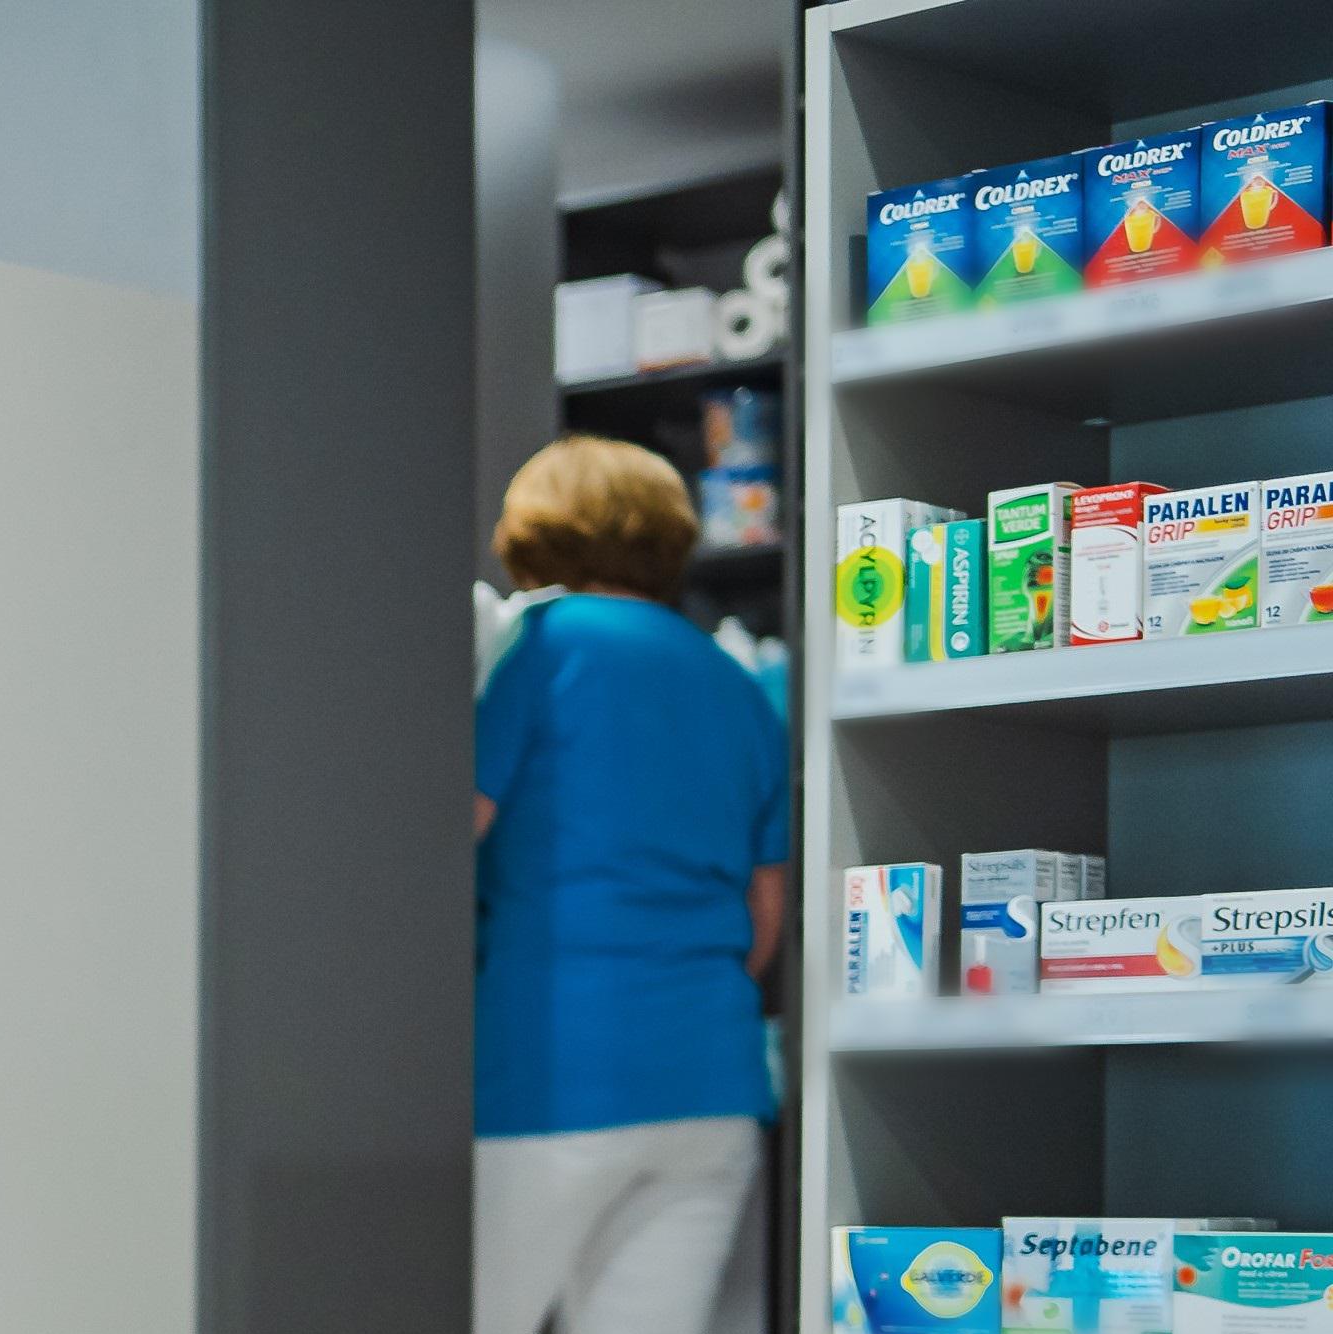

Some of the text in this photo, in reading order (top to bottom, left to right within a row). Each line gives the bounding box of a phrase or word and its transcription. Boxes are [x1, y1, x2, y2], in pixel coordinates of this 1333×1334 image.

[1212, 116, 1304, 151] COLDREX
[1097, 143, 1186, 177] COLDREX
[974, 173, 1072, 211] COLDREX
[879, 193, 960, 226] COLDREX
[1147, 491, 1250, 525] PARALEN
[1266, 506, 1317, 531] GRIP
[1147, 521, 1196, 545] GRIP
[858, 514, 877, 655] ACYLPYRIN
[951, 547, 971, 626] ASPIRIN
[1147, 615, 1163, 628] 12
[1265, 605, 1282, 619] 12
[1046, 906, 1161, 937] Strepfen
[846, 910, 863, 995] PARALEN
[1019, 1232, 1159, 1264] Septabene
